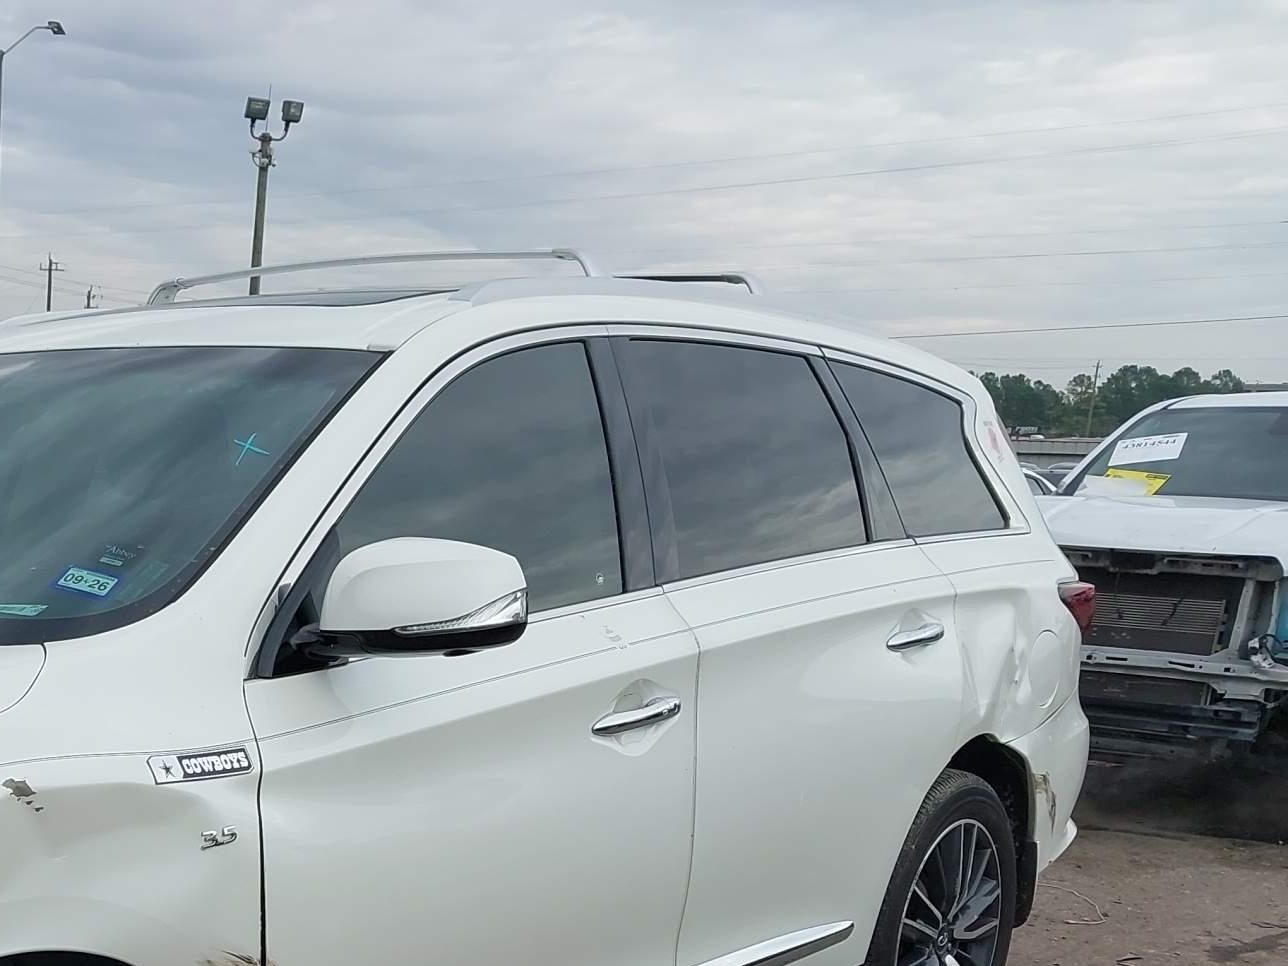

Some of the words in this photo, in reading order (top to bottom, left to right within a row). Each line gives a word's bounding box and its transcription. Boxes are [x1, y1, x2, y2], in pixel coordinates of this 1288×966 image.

[63, 573, 85, 585] 09
[87, 578, 111, 592] 26
[181, 751, 249, 775] COWBOYS
